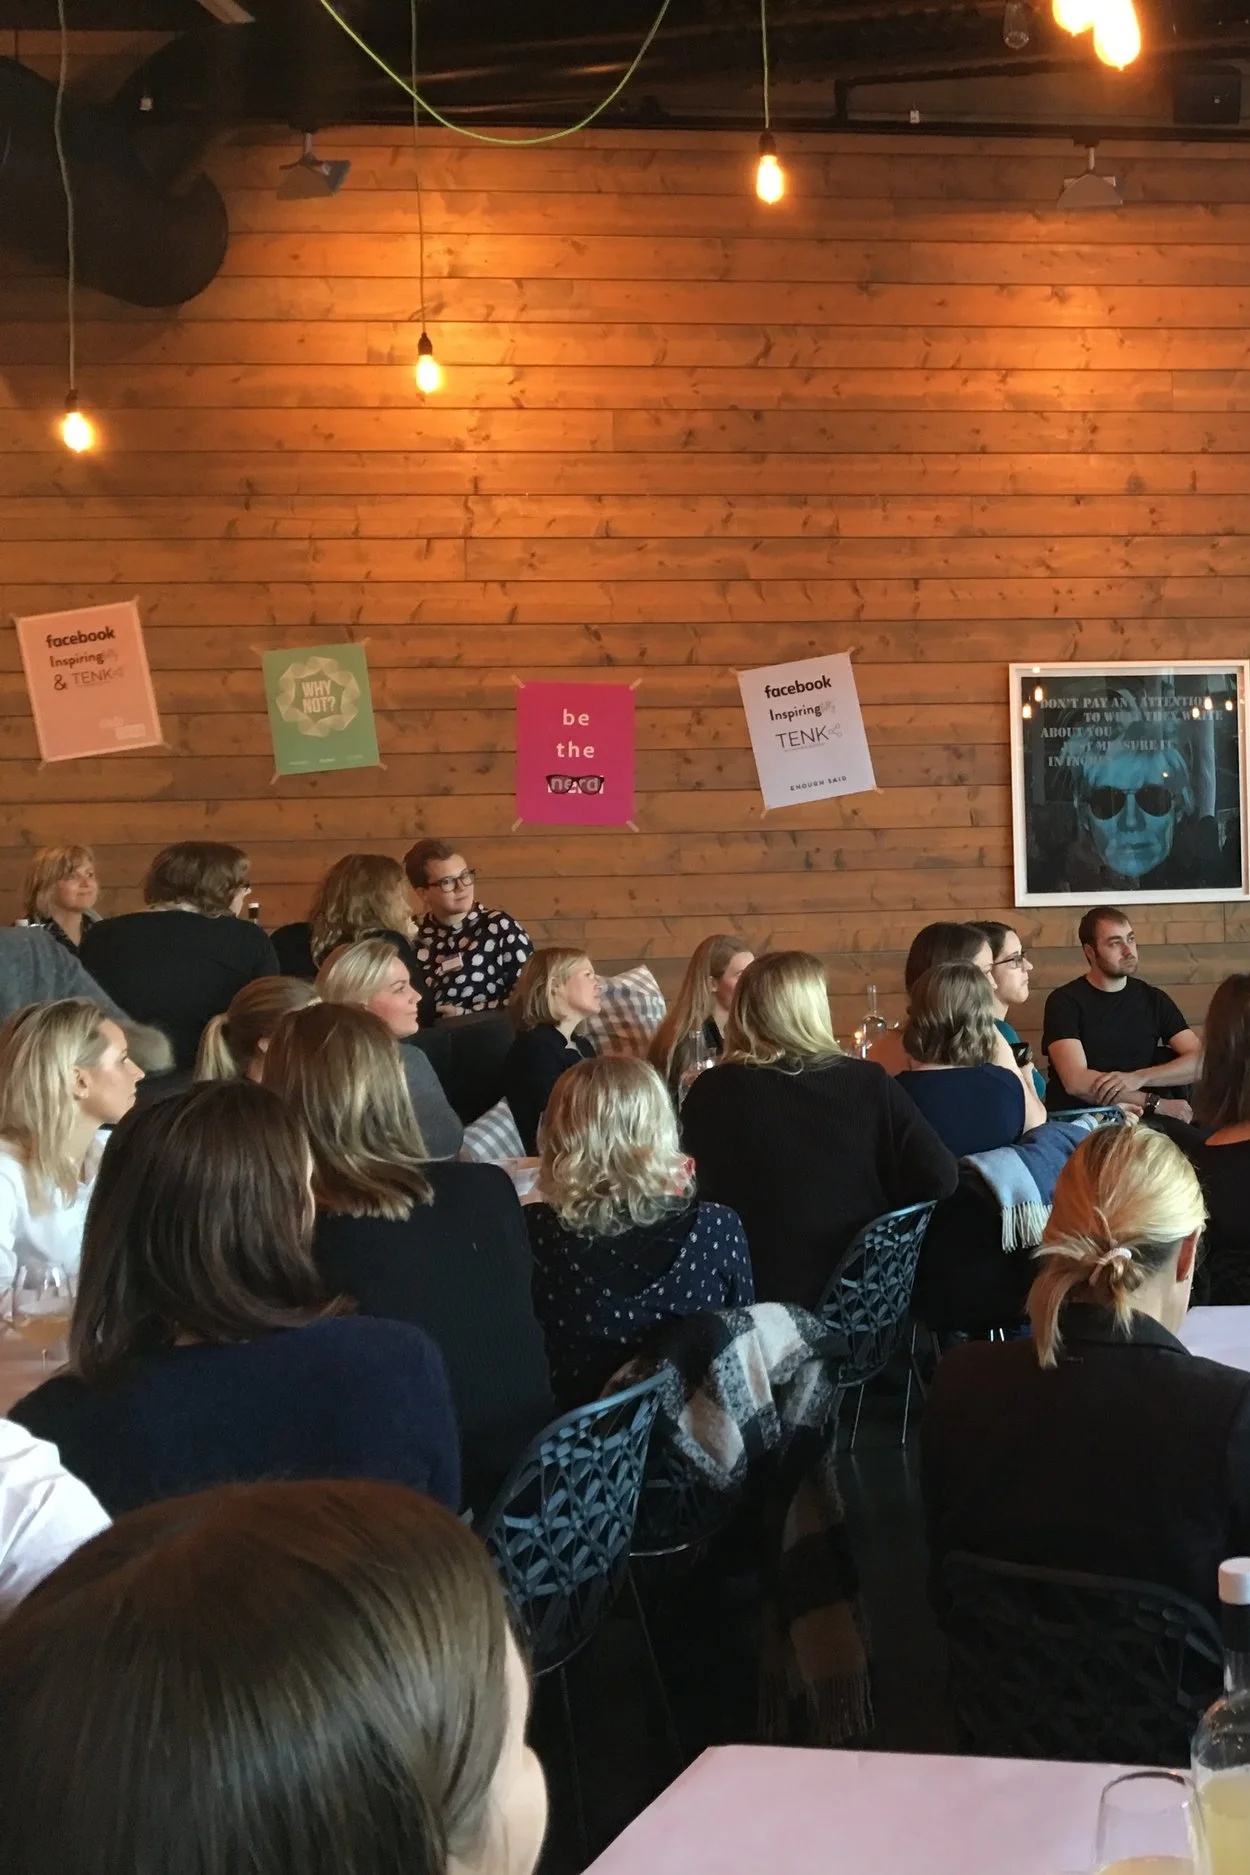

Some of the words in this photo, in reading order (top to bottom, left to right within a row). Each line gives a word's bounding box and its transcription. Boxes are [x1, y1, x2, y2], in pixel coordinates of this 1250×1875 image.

[46, 626, 116, 649] facebook
[72, 668, 114, 685] TENK
[301, 680, 331, 698] WHY
[764, 675, 832, 699] facebook
[302, 696, 336, 713] NOT?
[1040, 698, 1080, 709] DON'T
[1082, 697, 1109, 708] PAY
[1140, 696, 1212, 708] ATTENTIO
[563, 708, 590, 726] be
[1083, 712, 1101, 723] TO
[1181, 710, 1224, 721] WITE
[775, 725, 829, 748] TENK
[1040, 727, 1084, 738] ABOUT
[1086, 726, 1112, 738] YOU
[557, 741, 595, 758] the
[1096, 739, 1157, 751] MESURE
[1048, 756, 1063, 767] IN
[828, 775, 847, 785] SAID
